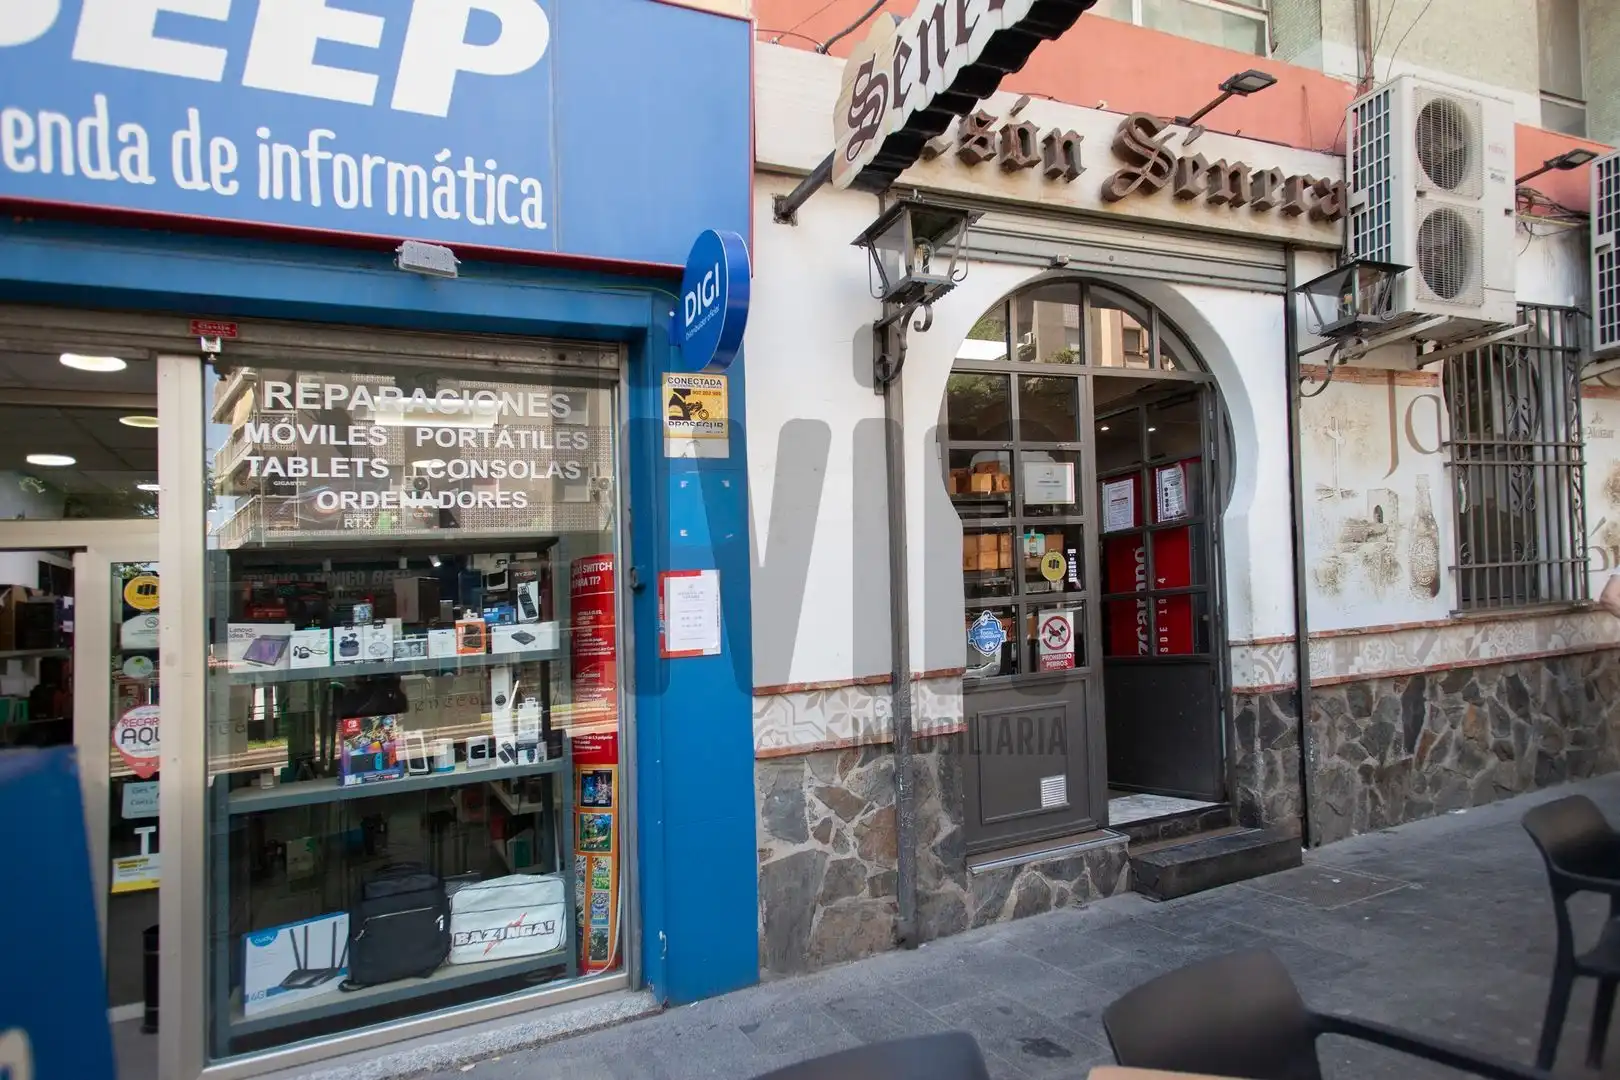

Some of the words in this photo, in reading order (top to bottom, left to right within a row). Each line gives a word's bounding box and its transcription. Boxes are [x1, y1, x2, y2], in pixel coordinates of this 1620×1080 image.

[0, 0, 549, 117] EEP
[2, 94, 156, 184] enda
[172, 108, 238, 196] de
[256, 127, 547, 229] informática
[685, 262, 719, 327] DIGI
[667, 377, 722, 386] CONECTADA
[264, 381, 571, 418] REPARACIONES
[244, 419, 388, 446] MÓVILES
[416, 424, 589, 450] PORTÁTILES
[245, 456, 390, 478] TABLETS
[427, 458, 582, 480] CONSOLAS
[317, 490, 527, 510] ORDENADORES
[344, 518, 373, 529] RTX
[582, 562, 613, 573] SWITCH
[1041, 653, 1072, 661] PROHIBIDO
[1046, 660, 1069, 668] PERROS
[454, 920, 555, 948] BAZINGA!
